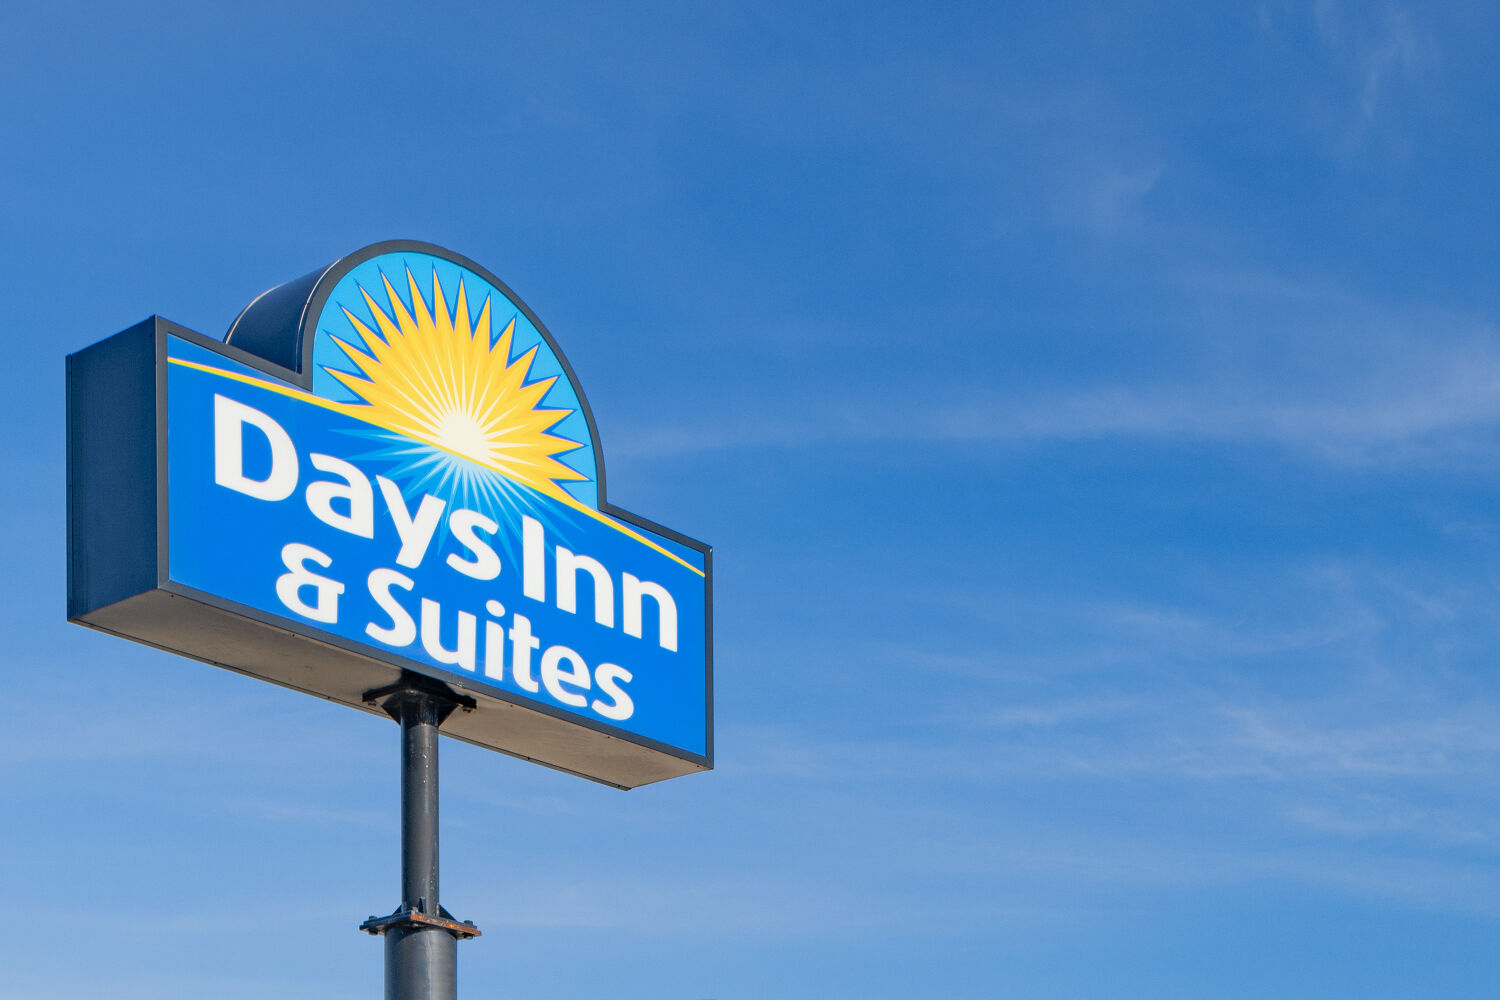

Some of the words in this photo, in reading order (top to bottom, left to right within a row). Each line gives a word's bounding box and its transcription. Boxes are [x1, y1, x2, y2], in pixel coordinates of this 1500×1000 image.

[214, 393, 502, 581] Days
[522, 514, 679, 653] Inn
[275, 542, 345, 624] &
[365, 567, 635, 721] Suites
